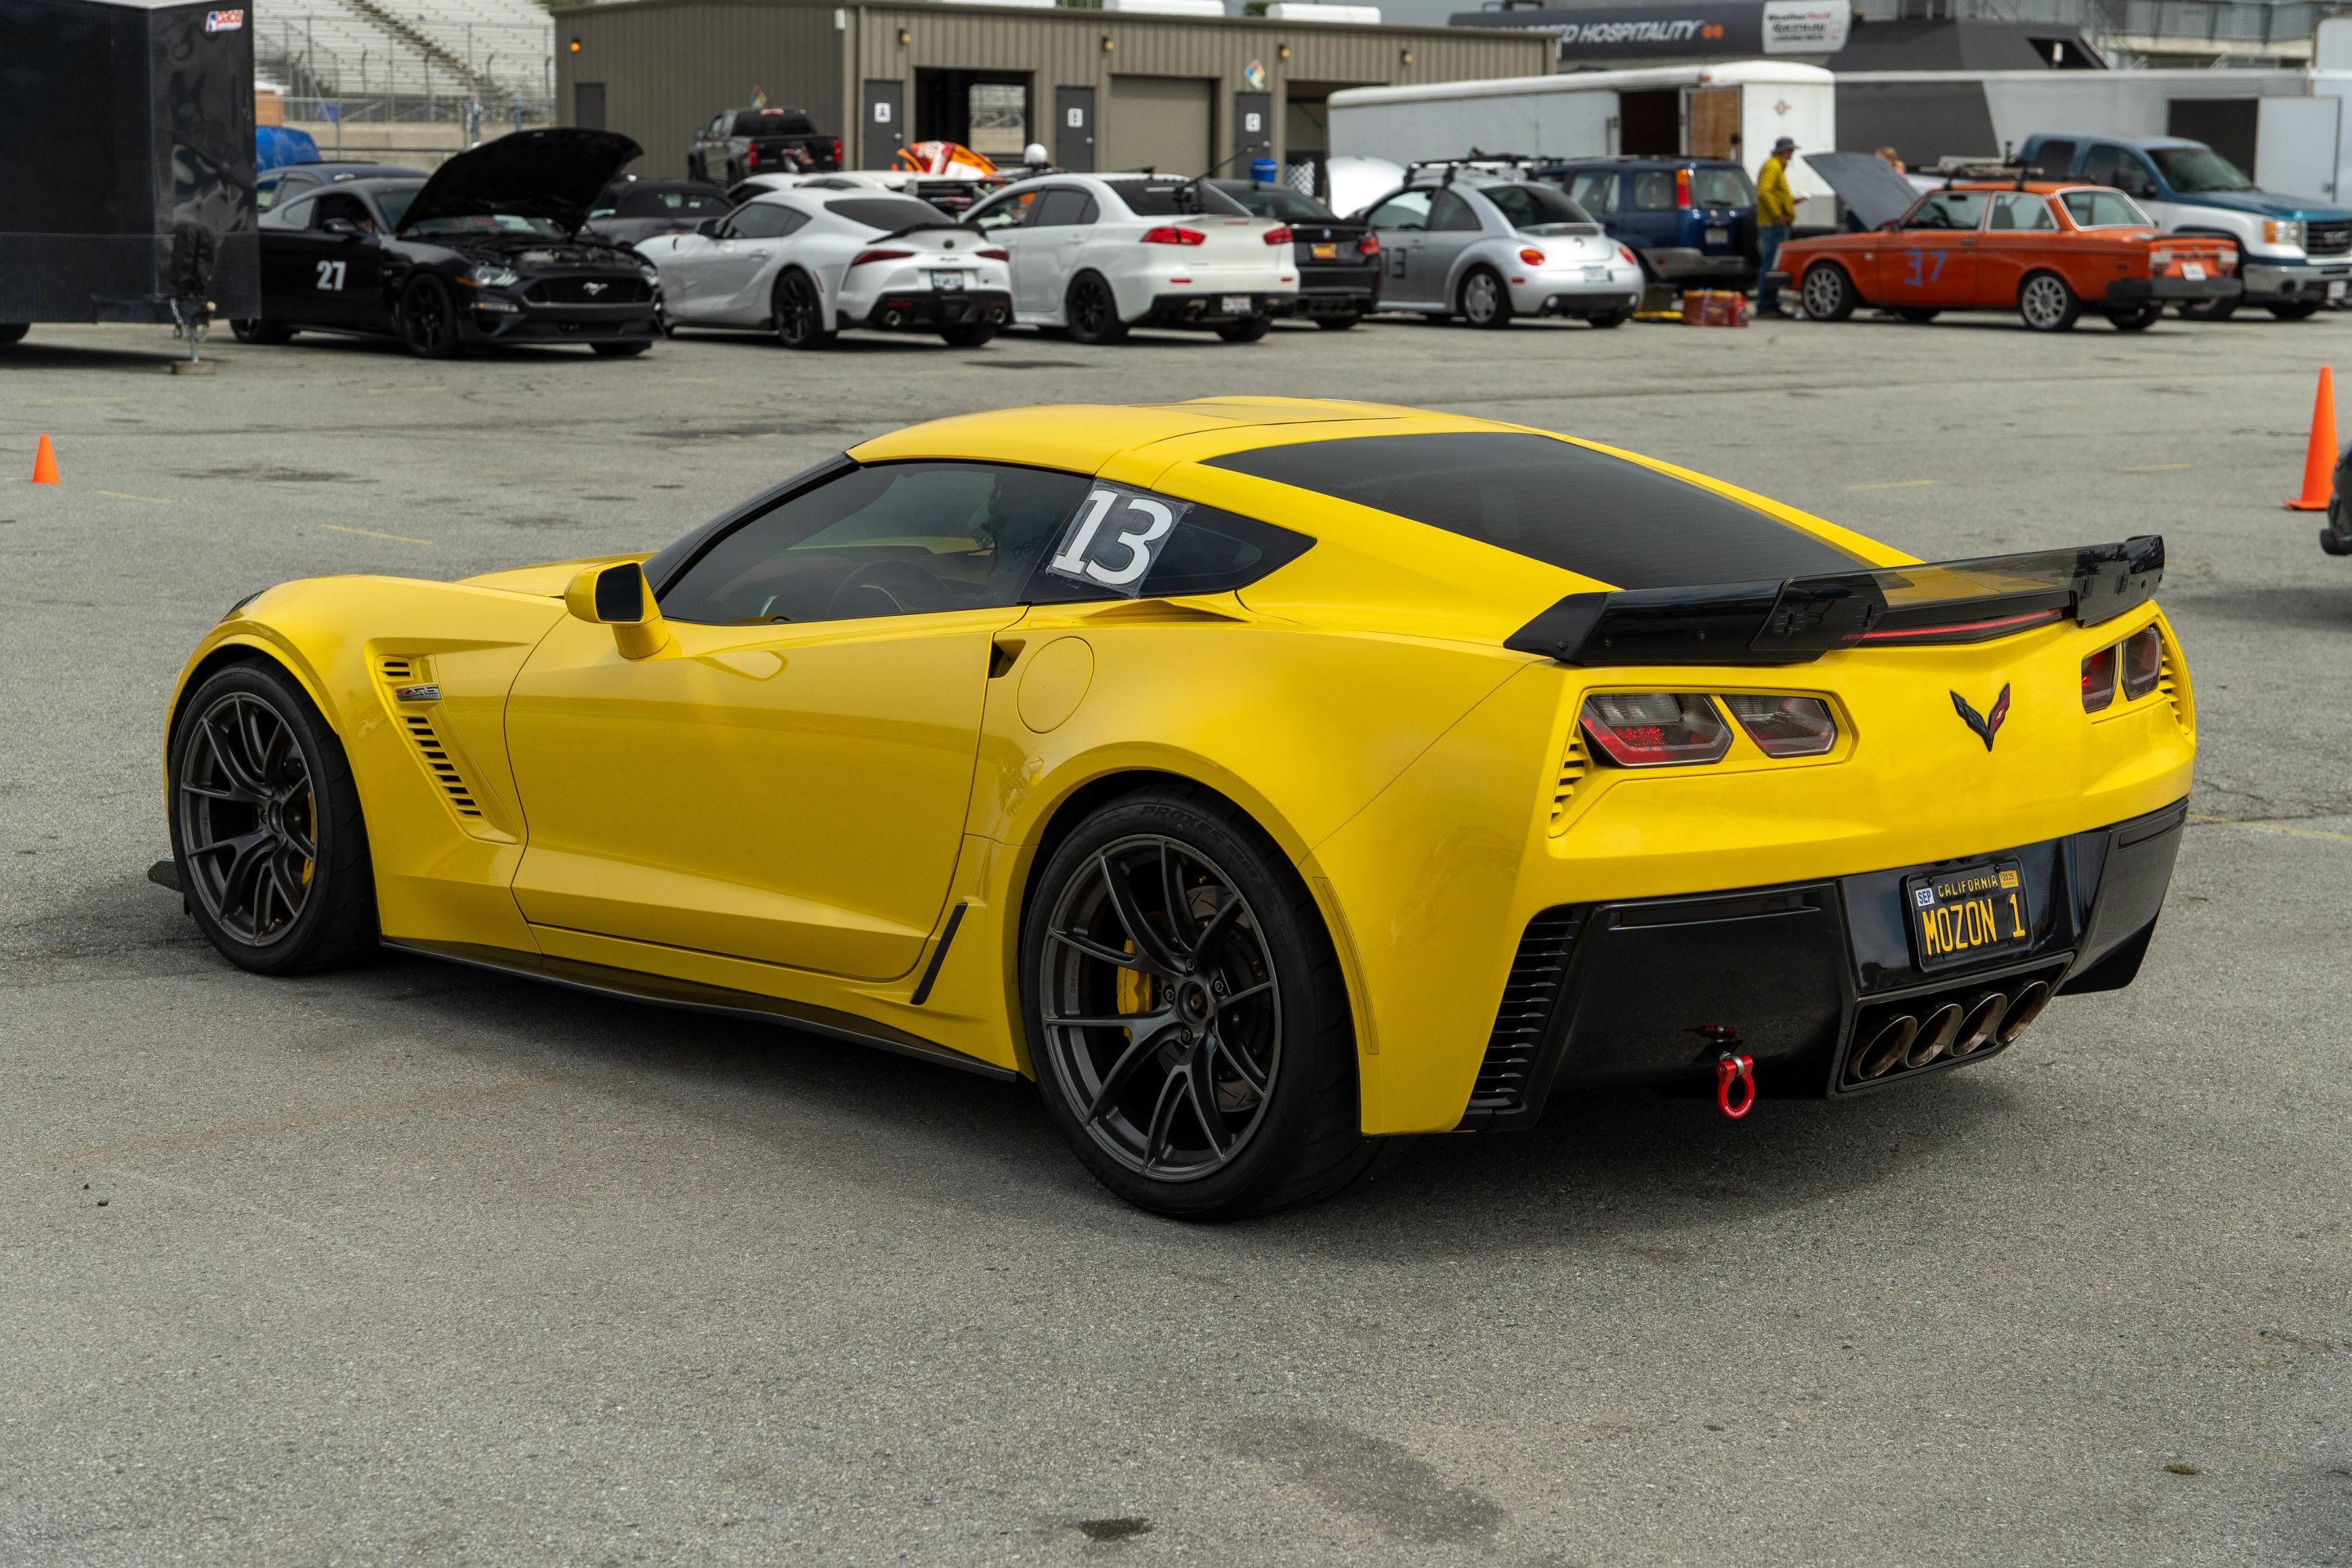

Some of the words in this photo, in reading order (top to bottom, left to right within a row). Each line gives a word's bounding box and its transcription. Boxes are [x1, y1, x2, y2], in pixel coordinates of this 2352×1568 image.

[1579, 20, 1704, 43] HOSPITALITY
[316, 260, 346, 292] 27
[1904, 249, 1948, 287] 37
[1052, 490, 1173, 585] 13
[1141, 806, 1225, 843] PROXES
[1937, 875, 1998, 898] CALIFORNIA
[2002, 873, 2015, 881] 2025
[1918, 890, 1932, 905] SEP
[1922, 898, 1998, 956] MOZON
[2009, 893, 2026, 938] 1
